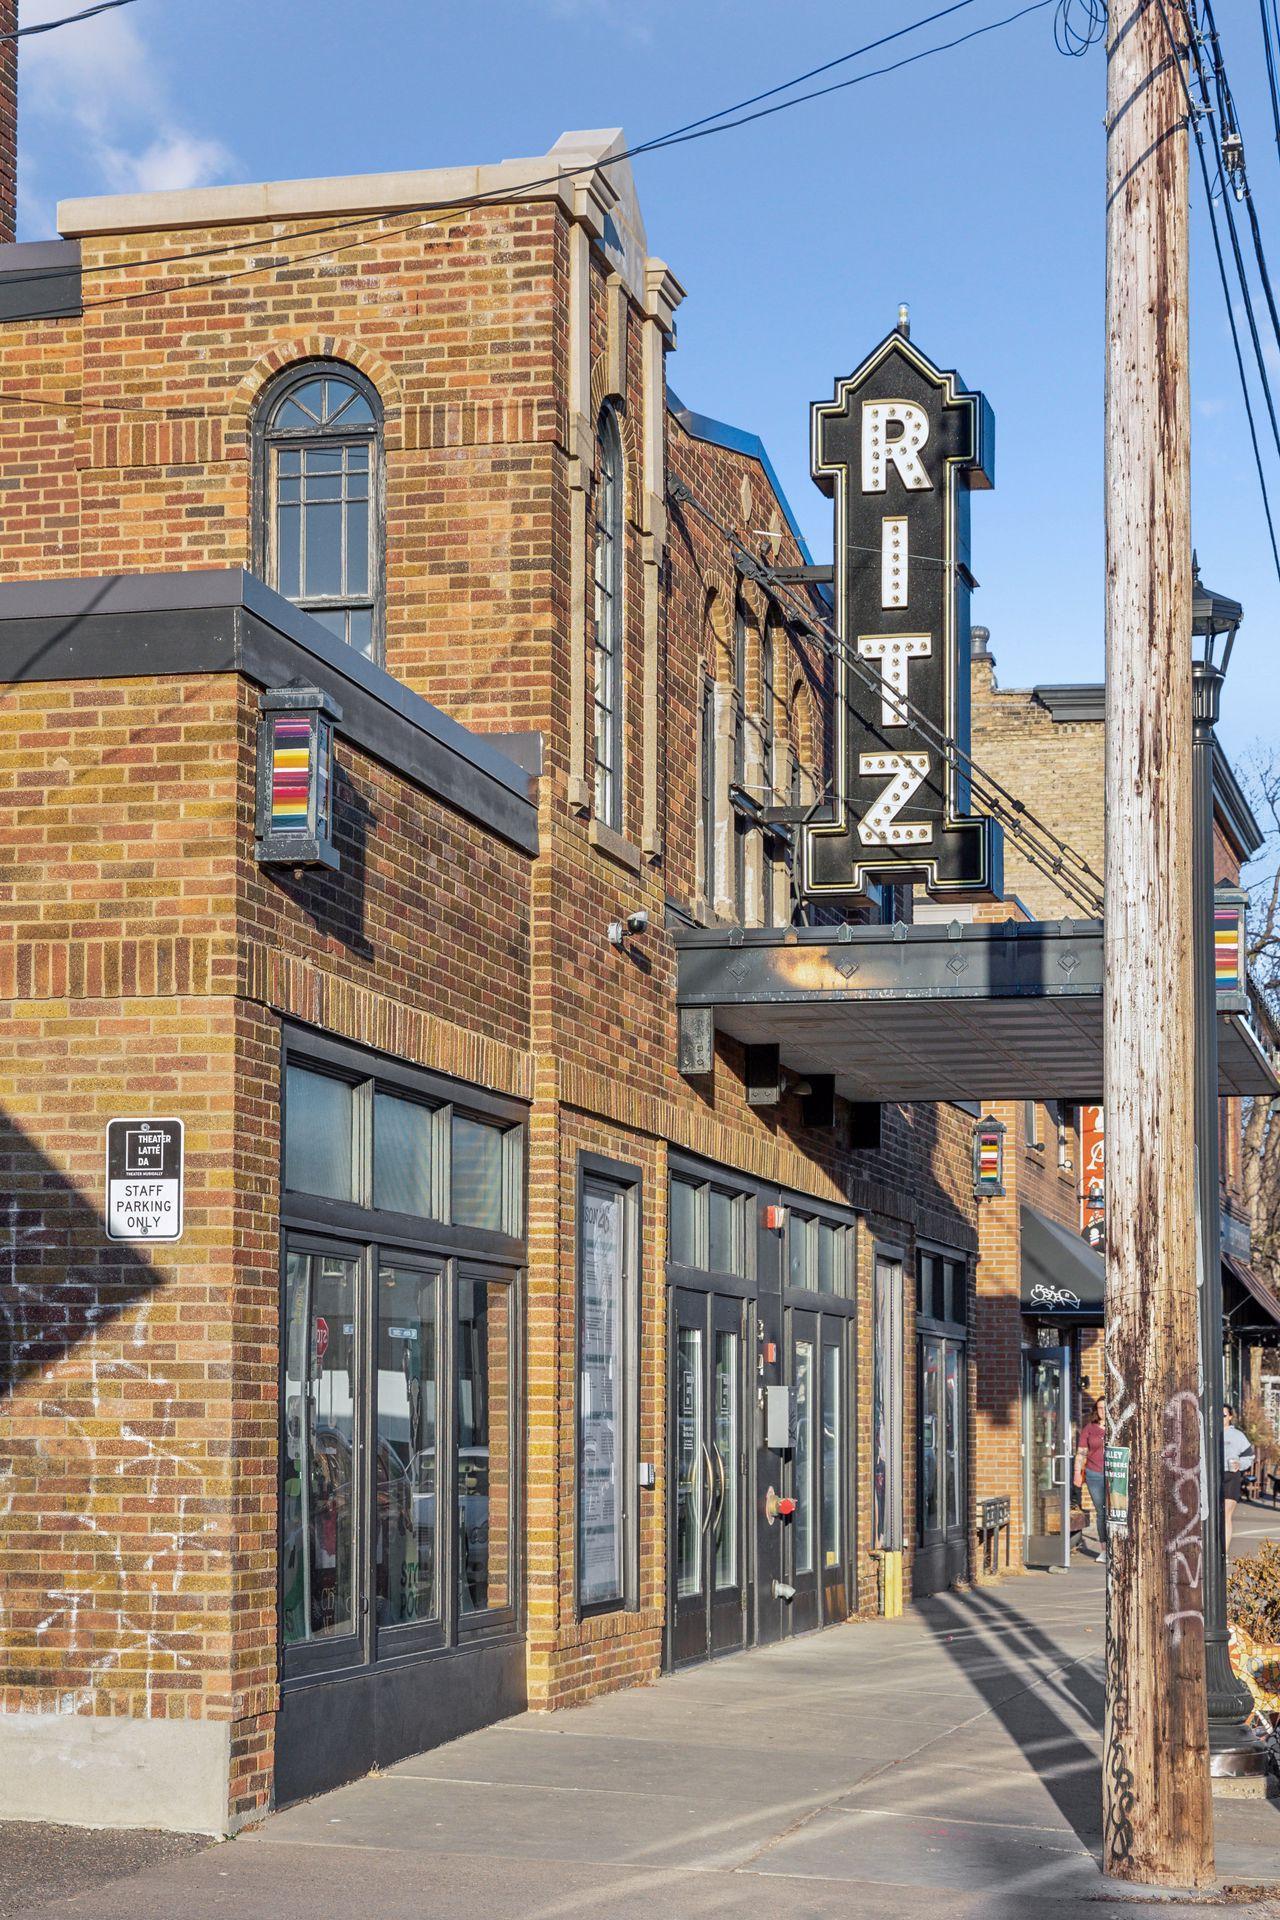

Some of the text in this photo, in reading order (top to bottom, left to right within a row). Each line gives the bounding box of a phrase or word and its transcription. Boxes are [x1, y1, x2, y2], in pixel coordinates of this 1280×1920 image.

[858, 398, 934, 847] RITZ
[138, 1134, 172, 1143] THEATER
[138, 1144, 161, 1155] LATTÉ
[138, 1157, 150, 1166] DA
[125, 1185, 164, 1197] STAFF
[116, 1201, 172, 1212] PARKING
[127, 1216, 161, 1228] ONLY
